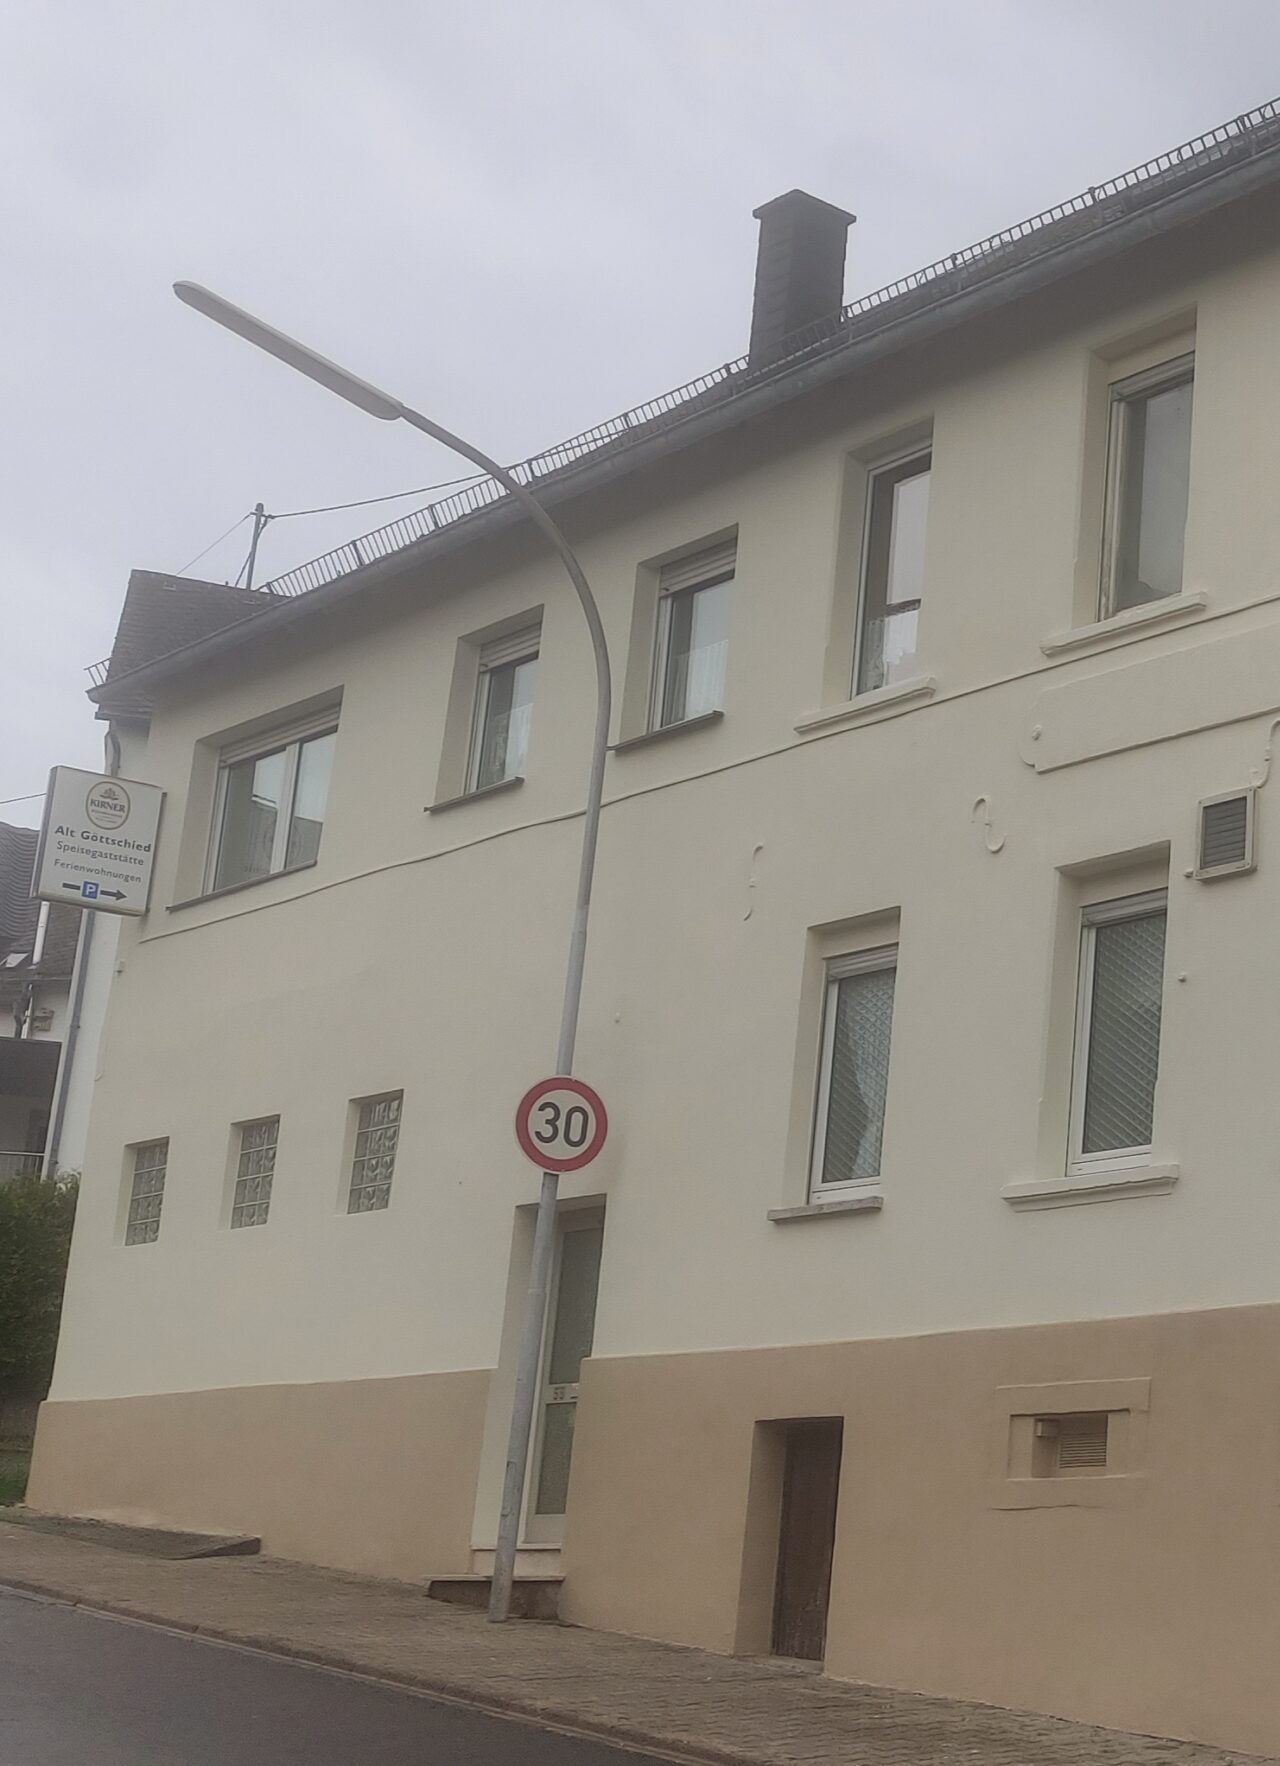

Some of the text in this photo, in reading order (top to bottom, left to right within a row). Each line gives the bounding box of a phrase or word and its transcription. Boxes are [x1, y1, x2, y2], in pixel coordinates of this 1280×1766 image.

[90, 798, 126, 813] KIRNER
[54, 825, 76, 838] Alt
[54, 858, 142, 883] Ferienwohnungen
[534, 1101, 589, 1148] 30
